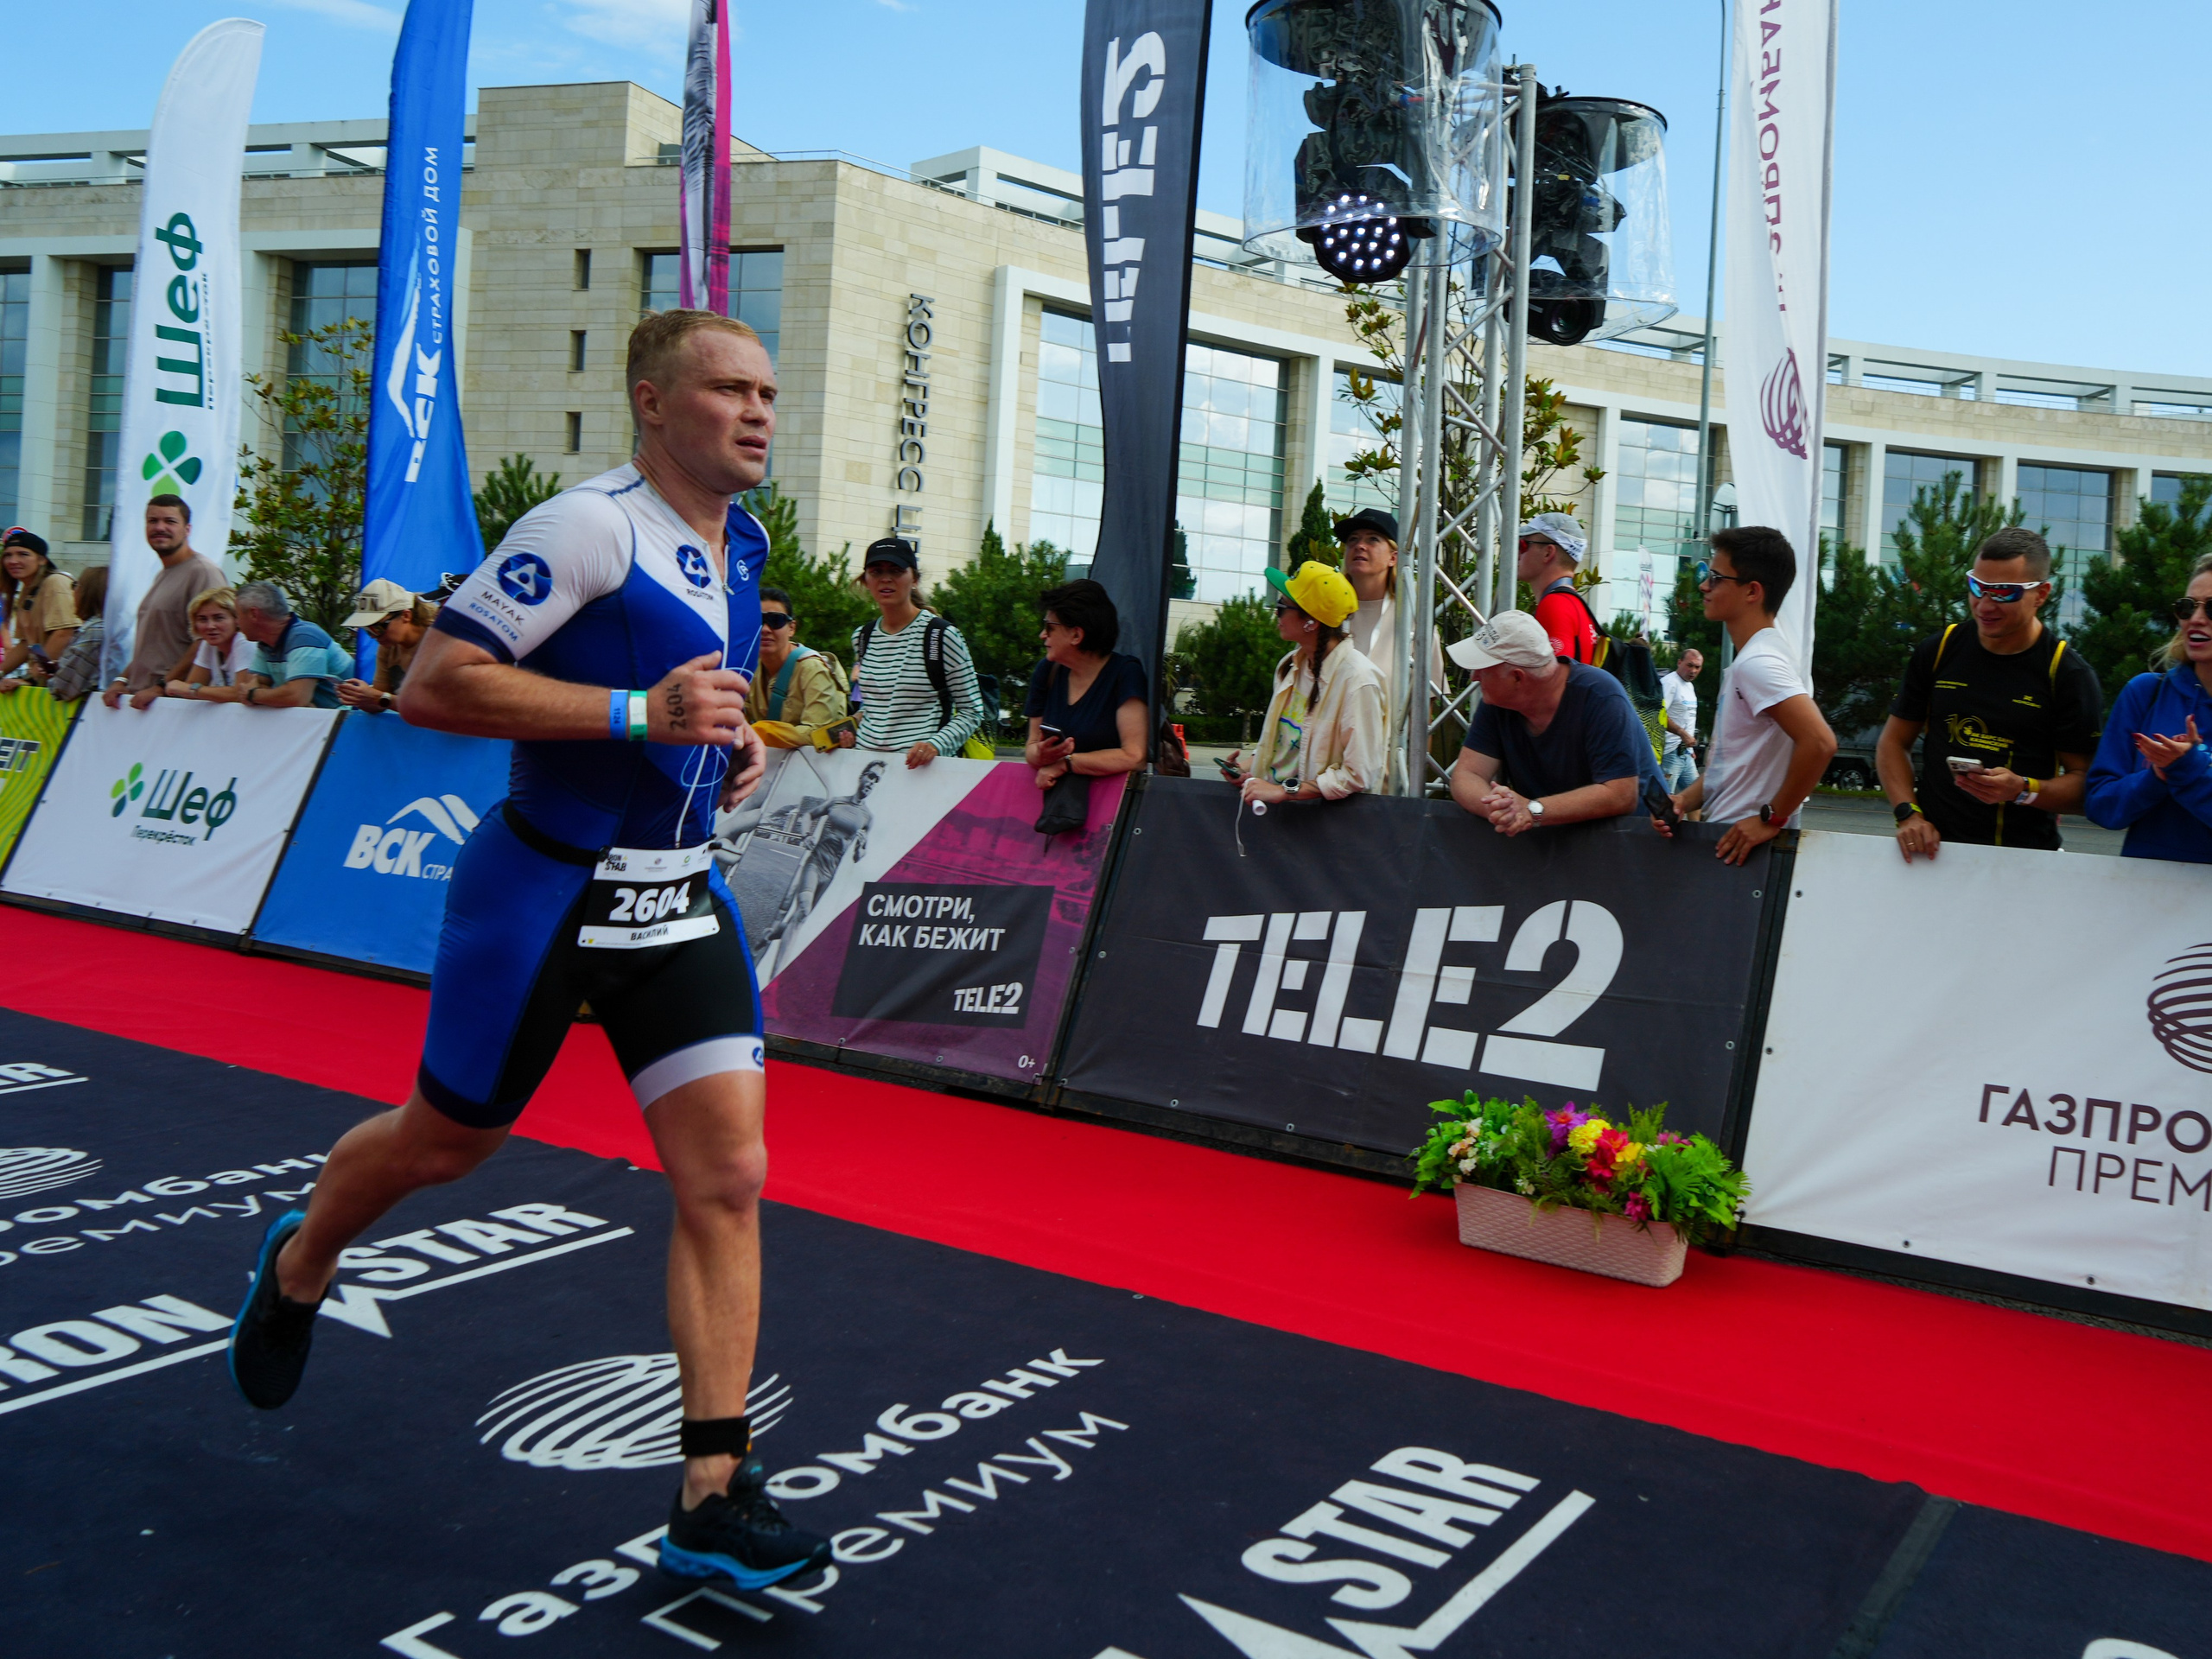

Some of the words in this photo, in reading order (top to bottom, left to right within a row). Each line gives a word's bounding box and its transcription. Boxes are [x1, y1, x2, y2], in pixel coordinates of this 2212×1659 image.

[423, 146, 440, 202] ДОМ
[421, 207, 443, 344] СТРАХОВОЙ
[155, 212, 204, 408] Шеф
[898, 293, 936, 493] КОНГРЕСС
[468, 601, 519, 642] ROSATOM
[480, 590, 525, 626] MAYAK
[666, 683, 687, 732] 2604
[141, 769, 238, 841] Шеф
[343, 823, 437, 878] ВСК
[608, 880, 691, 923] 2604
[867, 894, 976, 924] СМОТРИ,
[630, 924, 670, 941] ВАСИЛИЙ
[858, 924, 912, 948] КАК
[912, 925, 1006, 951] БЕЖИТ
[953, 982, 1023, 1014] TELE2
[1197, 900, 1624, 1091] TELE2
[1017, 1055, 1036, 1069] 0+
[1979, 1084, 2212, 1154] ГАЗПРО
[2049, 1146, 2212, 1212] ПРЕМ
[337, 1203, 610, 1282] STAR
[1242, 1446, 1541, 1611] STAR
